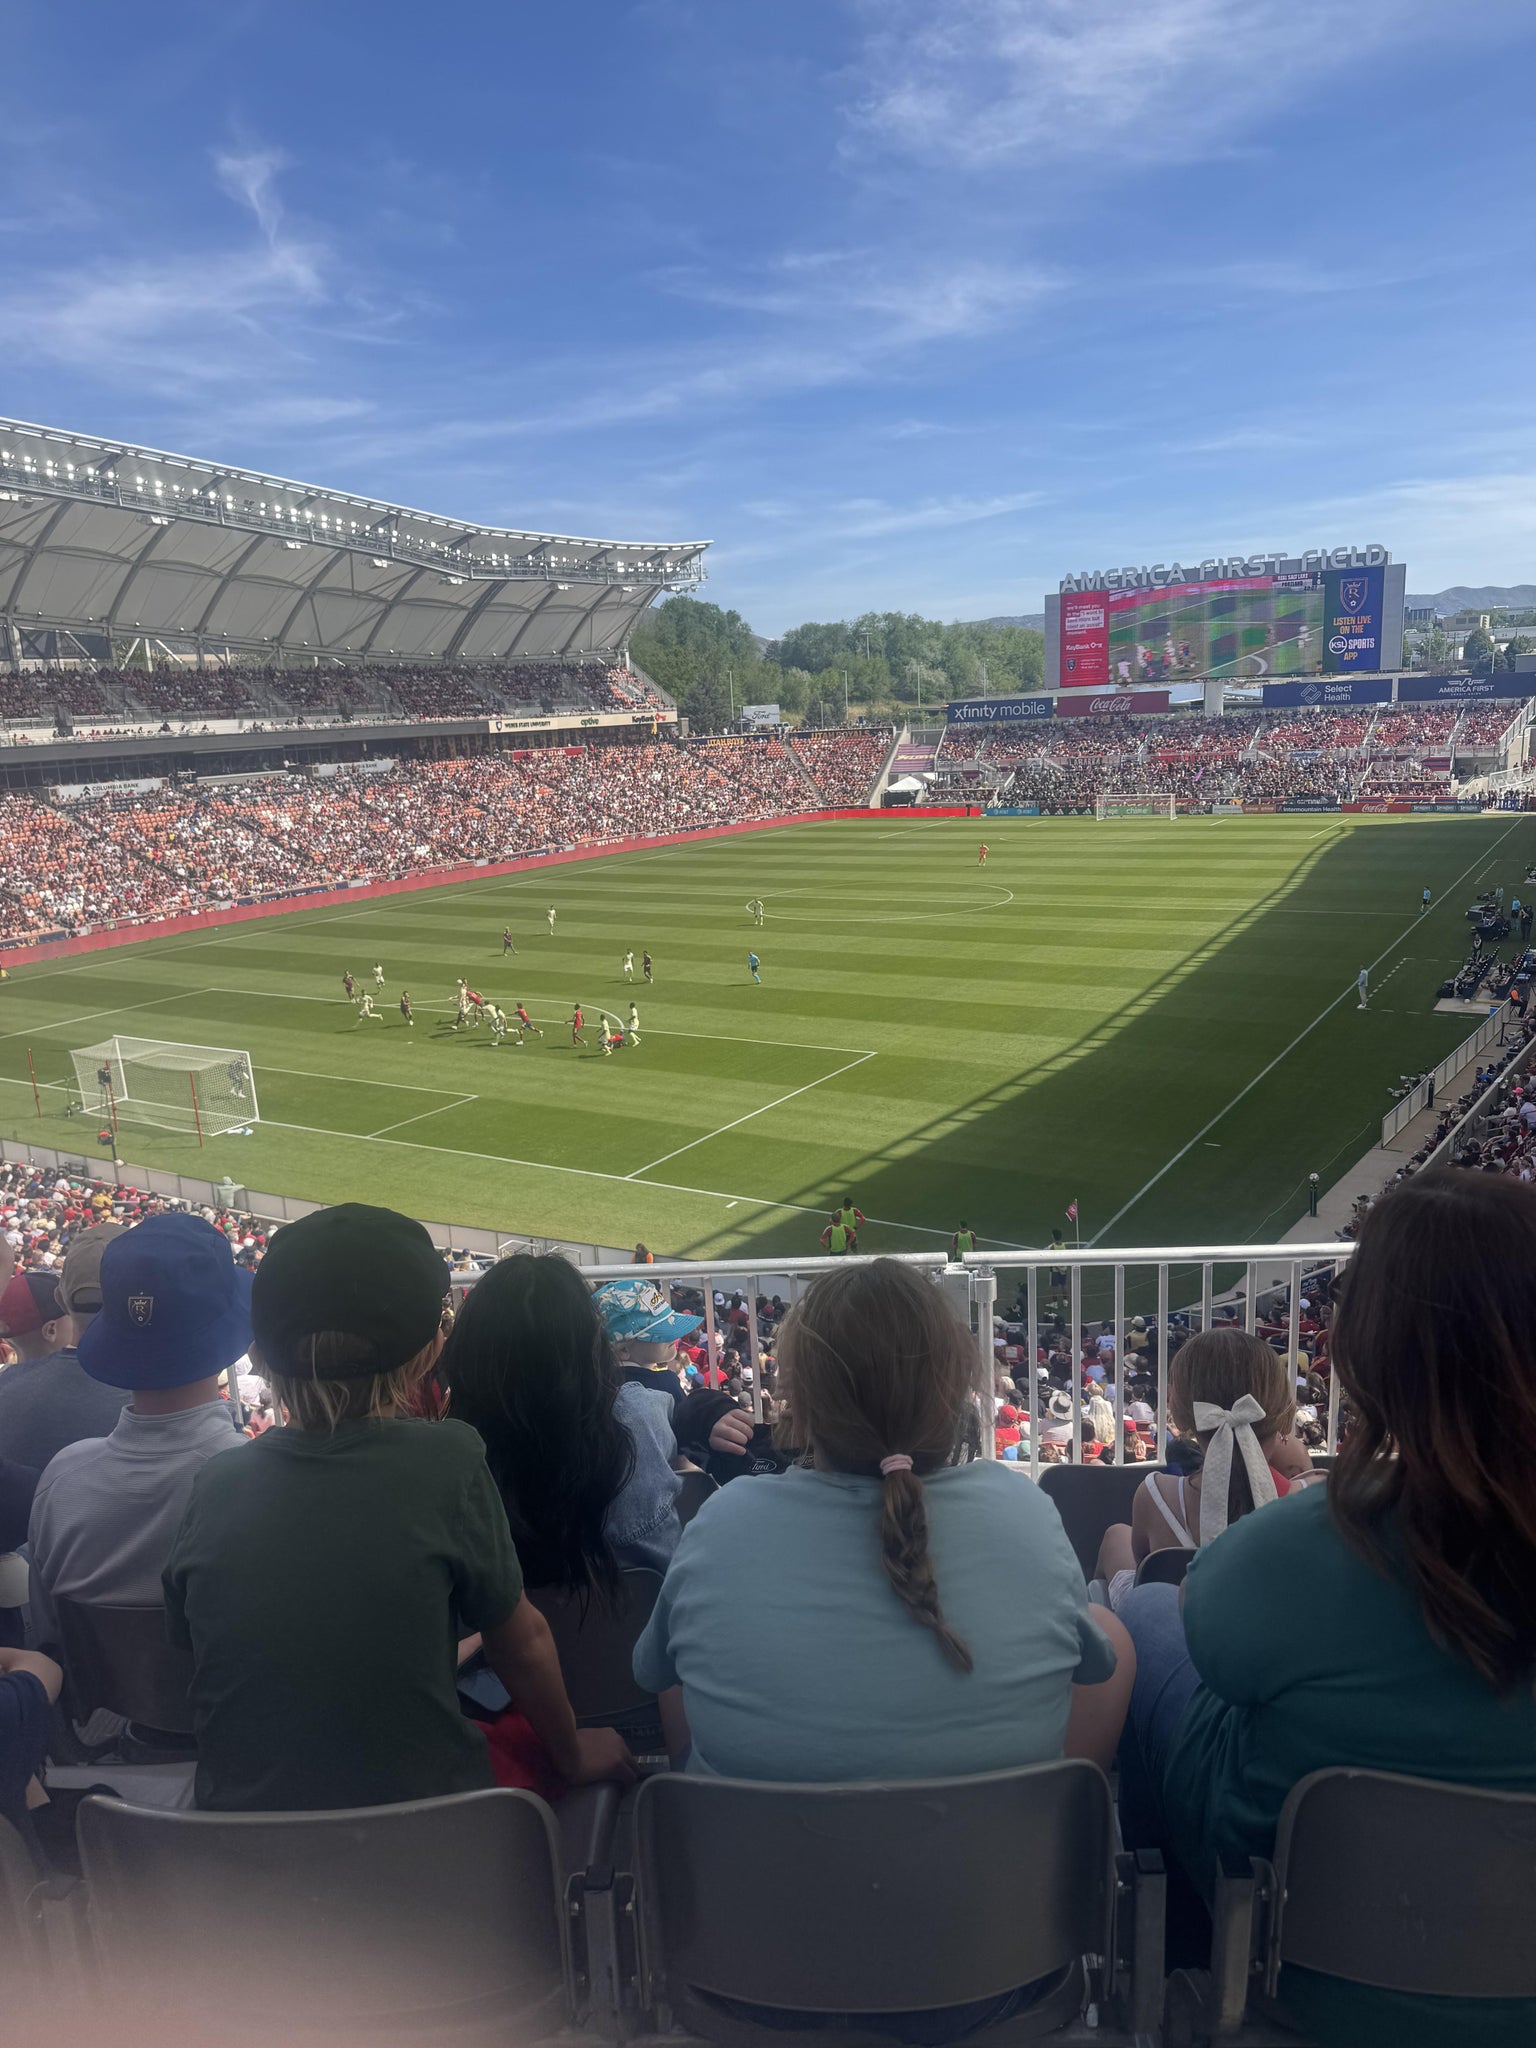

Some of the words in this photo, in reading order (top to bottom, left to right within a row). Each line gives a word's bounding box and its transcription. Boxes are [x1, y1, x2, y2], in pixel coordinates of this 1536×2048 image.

[1060, 562, 1186, 593] AMERICA
[1199, 552, 1288, 581] FIRST
[1301, 543, 1386, 572] FIELD
[1333, 616, 1356, 626] LISTEN
[1357, 615, 1372, 624] LIVE
[1340, 626, 1350, 635] ON
[1351, 625, 1364, 634] THE
[1348, 638, 1375, 650] SPORTS
[1343, 652, 1358, 661] APP
[1324, 684, 1352, 693] Select
[1324, 693, 1351, 701] Health
[751, 710, 772, 720] Ford
[954, 704, 997, 720] xfinity
[1000, 701, 1046, 716] mobile
[631, 715, 655, 724] KeyBank
[92, 784, 122, 792] COLUMBIA
